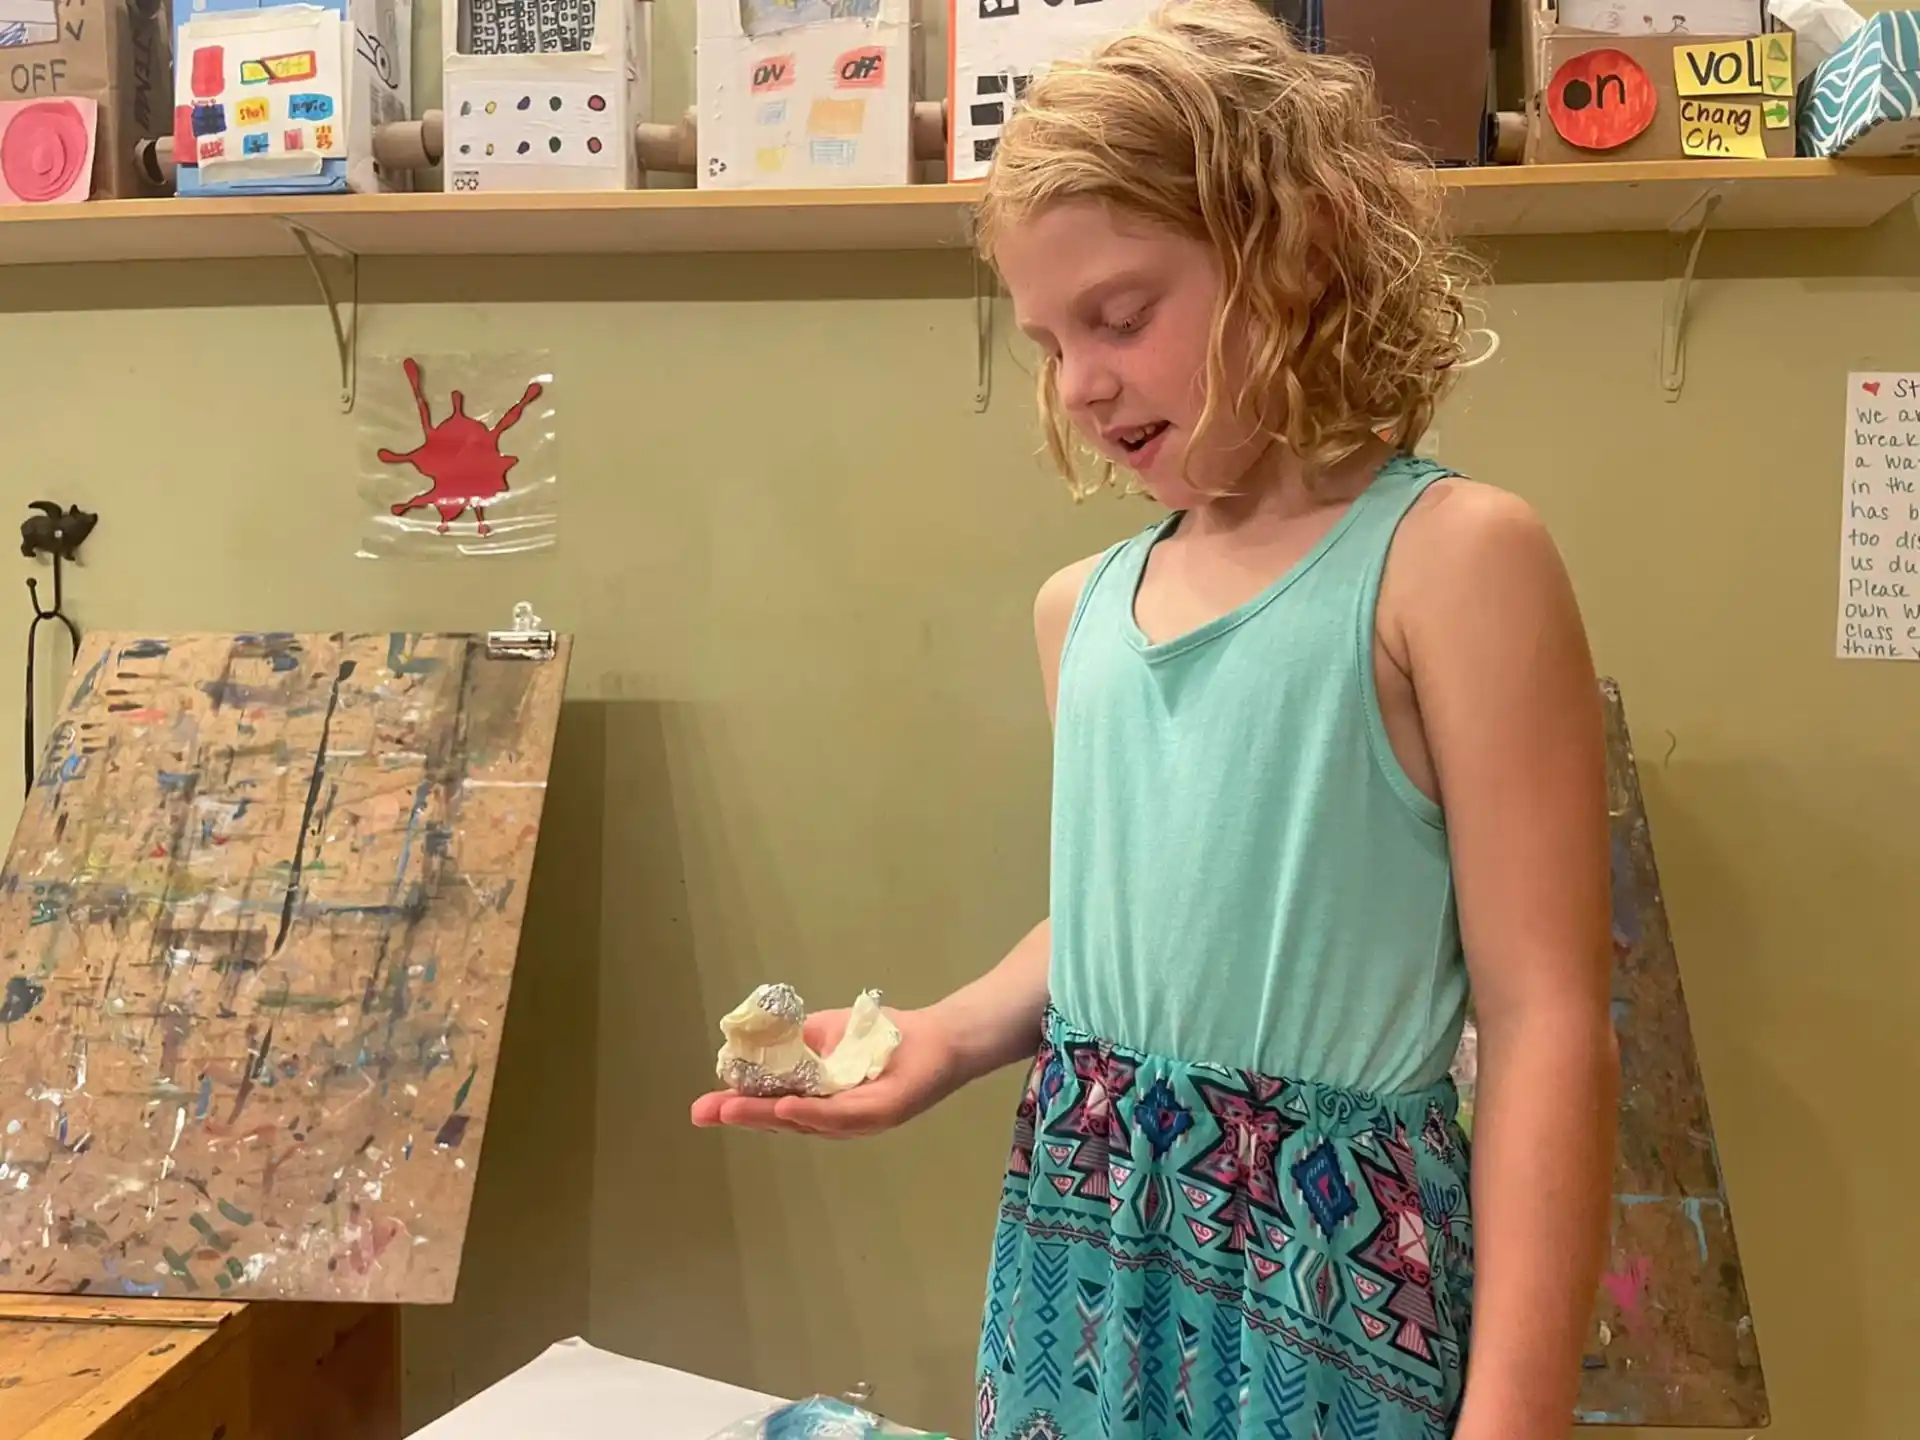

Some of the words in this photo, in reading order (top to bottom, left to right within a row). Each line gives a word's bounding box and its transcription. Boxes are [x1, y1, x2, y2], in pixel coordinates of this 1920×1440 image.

[1686, 40, 1763, 87] VOL
[11, 59, 67, 93] OFF
[1562, 74, 1626, 112] on
[1681, 101, 1752, 135] Chang
[1855, 428, 1920, 447] break
[1855, 456, 1871, 468] a
[1852, 479, 1871, 495] in
[1885, 476, 1916, 494] the
[1851, 500, 1889, 520] has
[1848, 528, 1880, 546] too
[1851, 556, 1873, 572] us
[1889, 554, 1919, 575] du
[1849, 578, 1910, 597] Please
[1843, 637, 1904, 656] think
